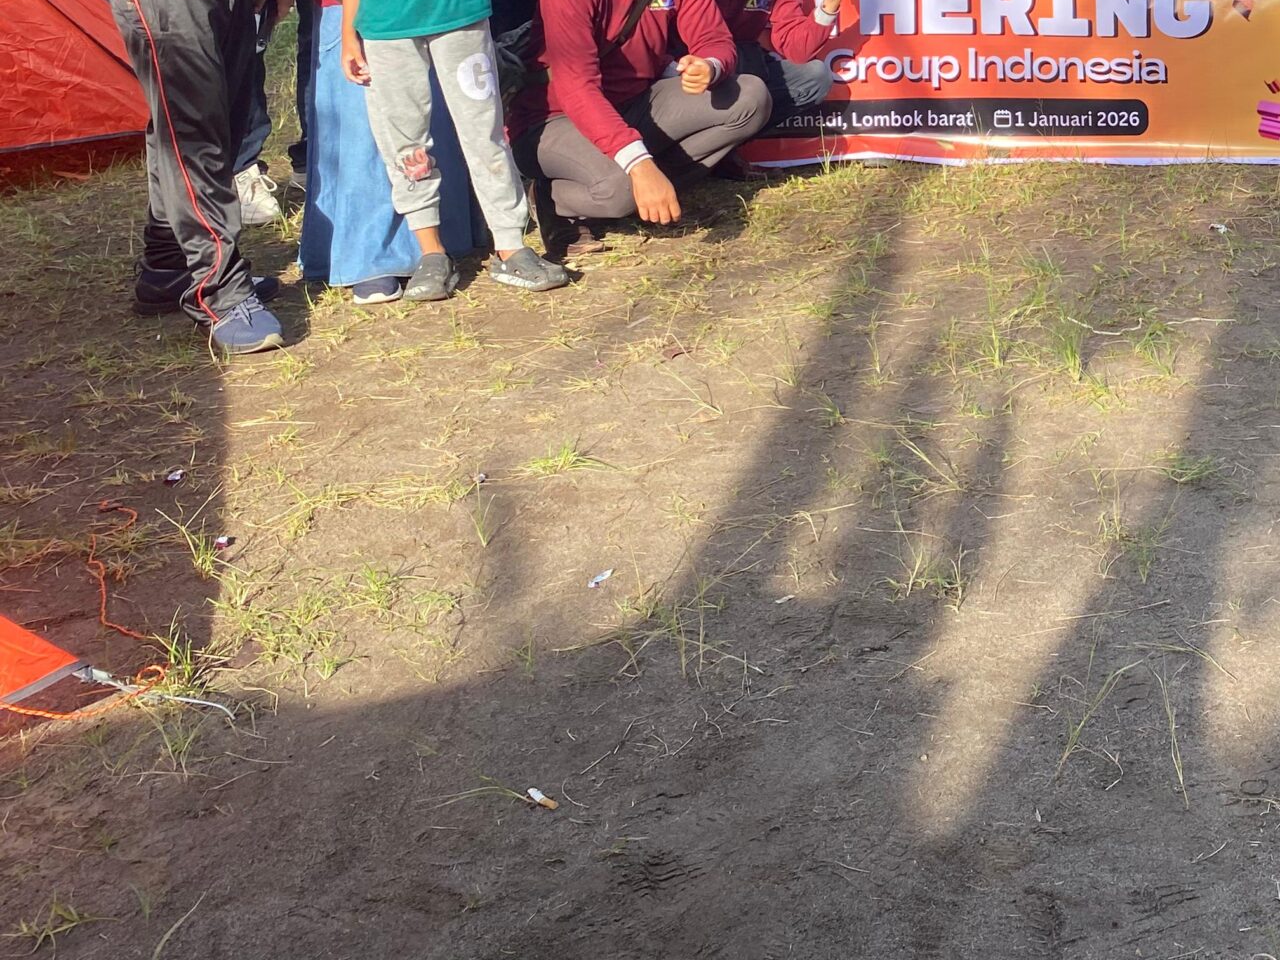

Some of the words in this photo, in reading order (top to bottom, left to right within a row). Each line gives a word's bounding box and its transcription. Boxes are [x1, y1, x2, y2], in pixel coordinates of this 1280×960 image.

[827, 47, 961, 90] Group
[968, 47, 1168, 84] Indonesia
[776, 111, 848, 130] ranadi,
[852, 110, 923, 127] Lombok
[928, 110, 974, 127] barat
[1015, 112, 1025, 127] 1
[1028, 111, 1092, 128] Januari
[1097, 112, 1140, 128] 2026
